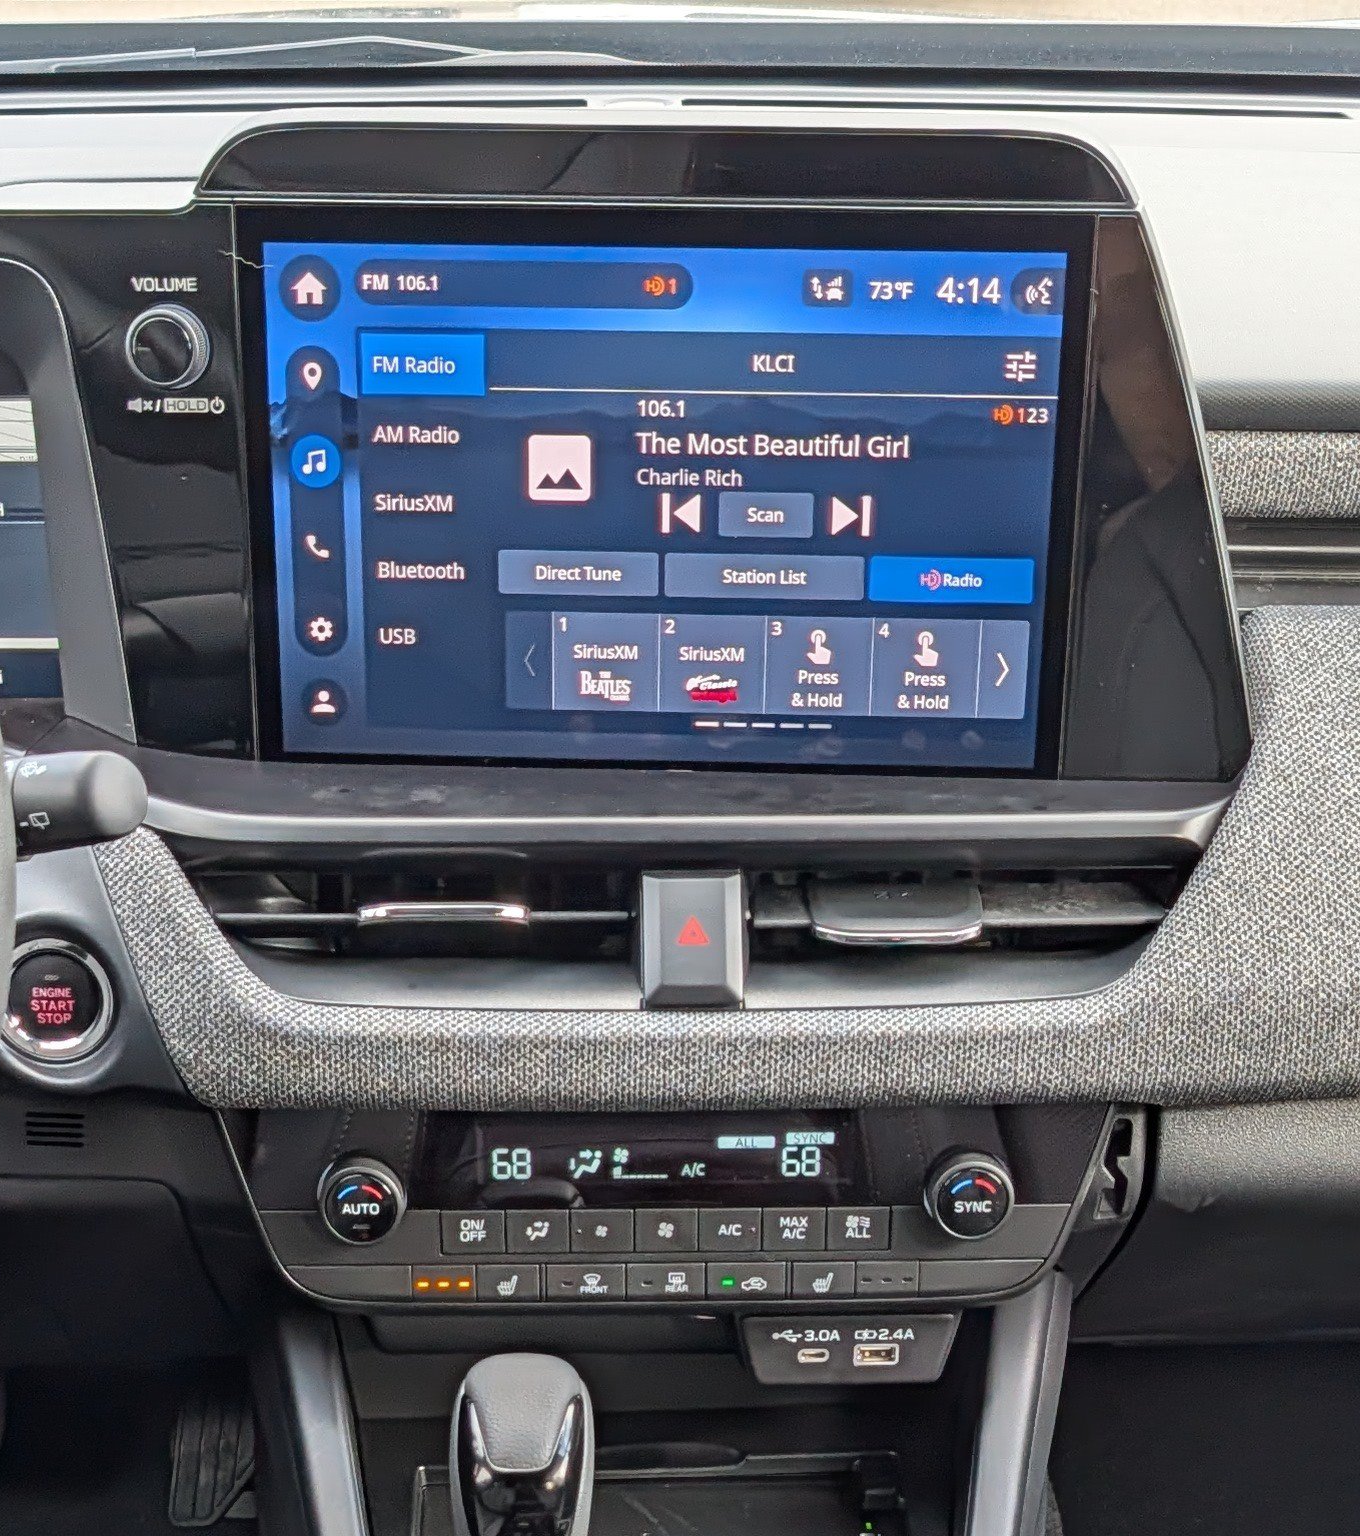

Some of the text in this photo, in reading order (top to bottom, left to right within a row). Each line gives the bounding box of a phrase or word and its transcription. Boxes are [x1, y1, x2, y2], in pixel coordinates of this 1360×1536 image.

[130, 277, 198, 292] VOLUME
[362, 274, 388, 291] FM
[397, 275, 439, 292] 106.1
[869, 281, 913, 300] 73°F
[937, 277, 1001, 304] 4:14
[373, 356, 455, 374] FM Radio
[752, 355, 795, 373] KLCI
[165, 399, 207, 412] HOLD
[637, 400, 686, 418] 106.1
[372, 426, 459, 444] AM Radio
[636, 432, 909, 458] The Most Beautiful Girl
[637, 469, 742, 487] Charlie Rich
[375, 494, 453, 512] SiriusXM
[747, 507, 784, 523] Scan
[377, 562, 465, 580] Bluetooth
[536, 565, 622, 582] Direct Tune
[722, 569, 806, 585] Station List
[943, 573, 982, 588] Radio
[559, 617, 568, 632] 1
[665, 619, 675, 634] 2
[771, 622, 782, 636] 3
[878, 623, 890, 638] 4
[379, 628, 416, 645] USB
[573, 644, 639, 660] SiriusXM
[679, 647, 744, 662] SiriusXM
[798, 671, 838, 685] Press
[905, 672, 946, 687] Press
[791, 694, 842, 708] & Hold
[898, 695, 949, 710] & Hold
[32, 987, 72, 998] ENGINE
[30, 1000, 75, 1012] START
[37, 1013, 72, 1024] STOP
[735, 1138, 757, 1148] ALL
[794, 1134, 827, 1144] SYNC
[492, 1148, 532, 1180] 68
[781, 1146, 820, 1177] 68
[681, 1163, 706, 1177] A/C
[342, 1203, 380, 1216] AUTO
[954, 1200, 992, 1213] SYNC
[460, 1218, 485, 1231] ON/
[780, 1216, 808, 1228] MAX
[460, 1231, 486, 1242] OFF
[718, 1223, 742, 1237] A/C
[782, 1228, 806, 1240] A/C
[845, 1227, 871, 1239] ALL
[580, 1285, 609, 1295] FRONT
[665, 1283, 689, 1293] REAR
[804, 1329, 840, 1342] 3.0A
[878, 1328, 915, 1341] 2.4A
